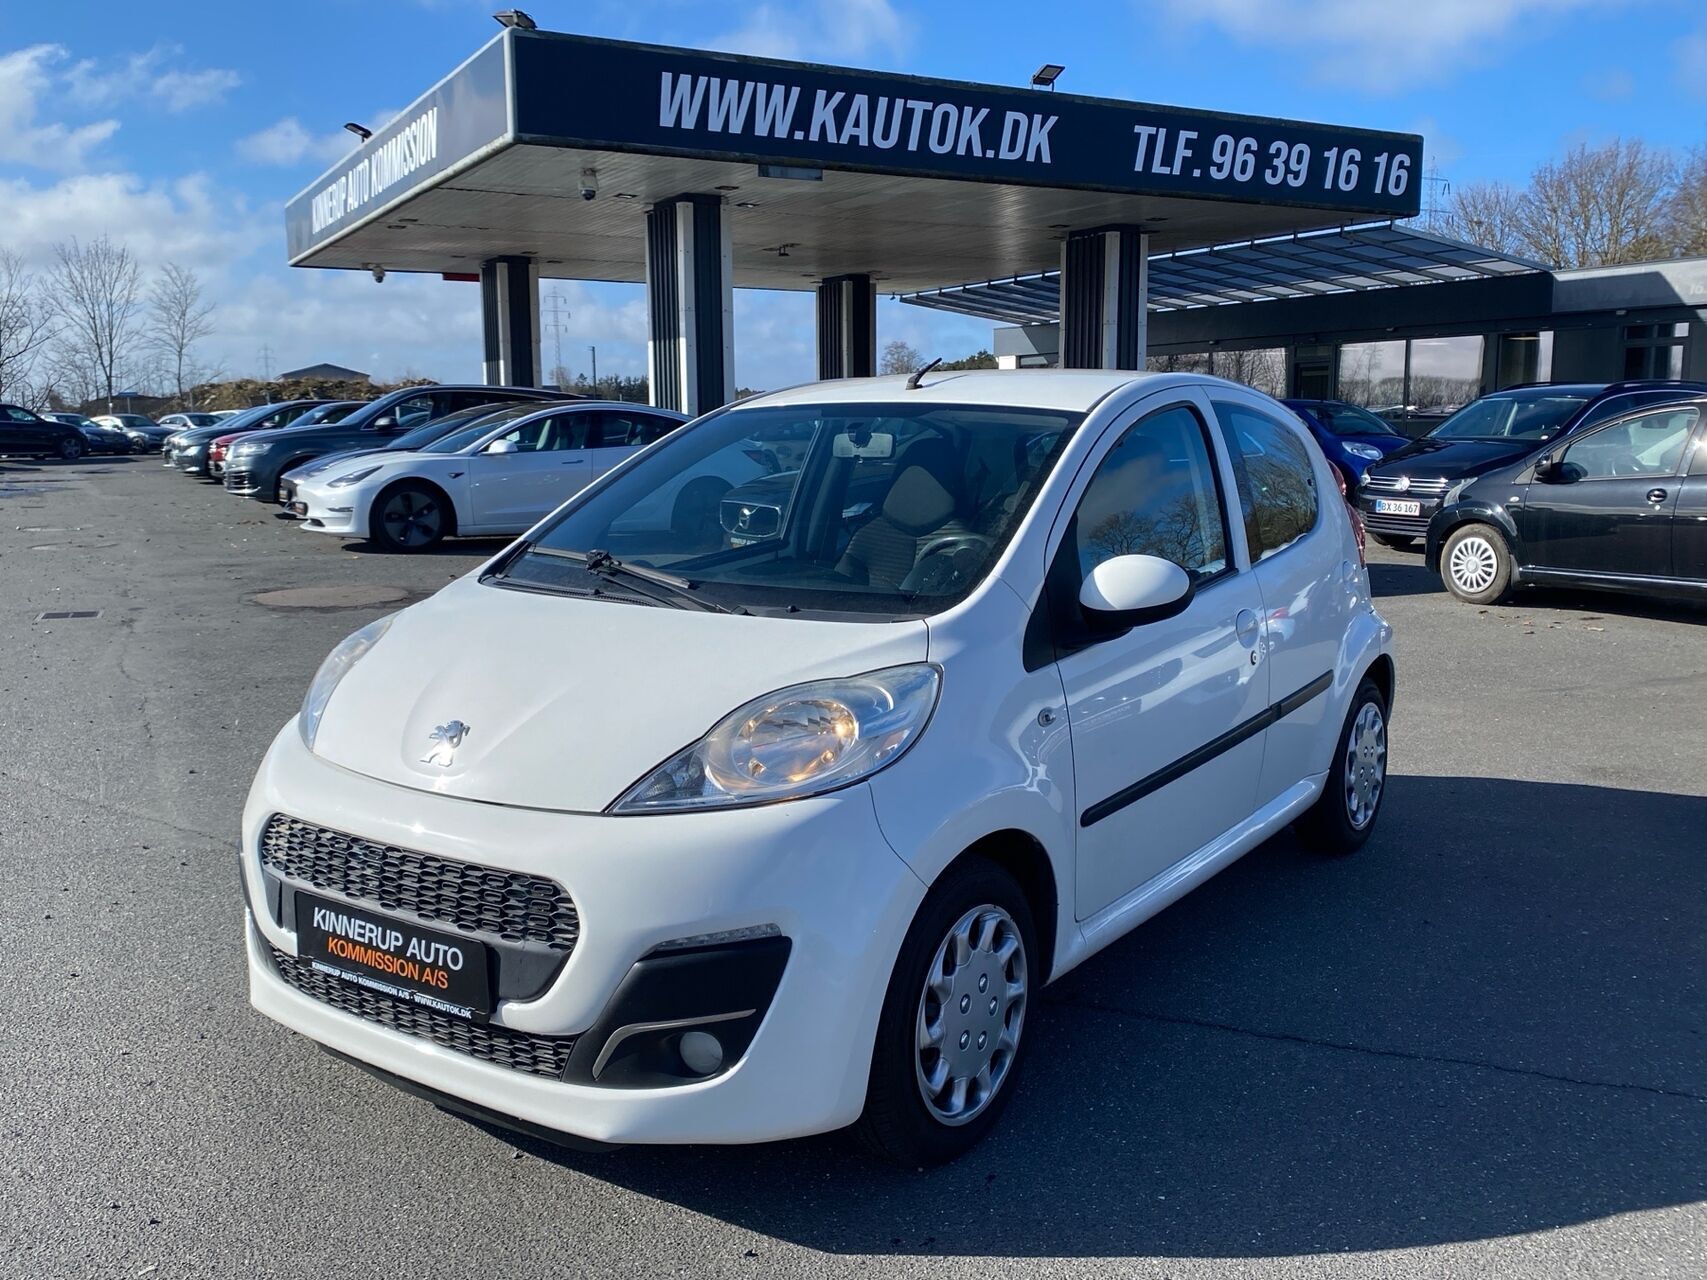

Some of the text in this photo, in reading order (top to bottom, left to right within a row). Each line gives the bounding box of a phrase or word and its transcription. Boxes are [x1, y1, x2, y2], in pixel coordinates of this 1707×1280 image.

[659, 71, 1059, 164] WWW.KAUTOK.DK
[312, 107, 438, 235] KINNERUP AUTO KOMMISSION
[1133, 124, 1411, 196] TLF. 96 39 16 16
[1404, 503, 1418, 513] 167
[313, 907, 464, 971] KINNERUP AUTO
[328, 937, 449, 989] KOMMISSION A/S
[341, 971, 357, 983] AUTO
